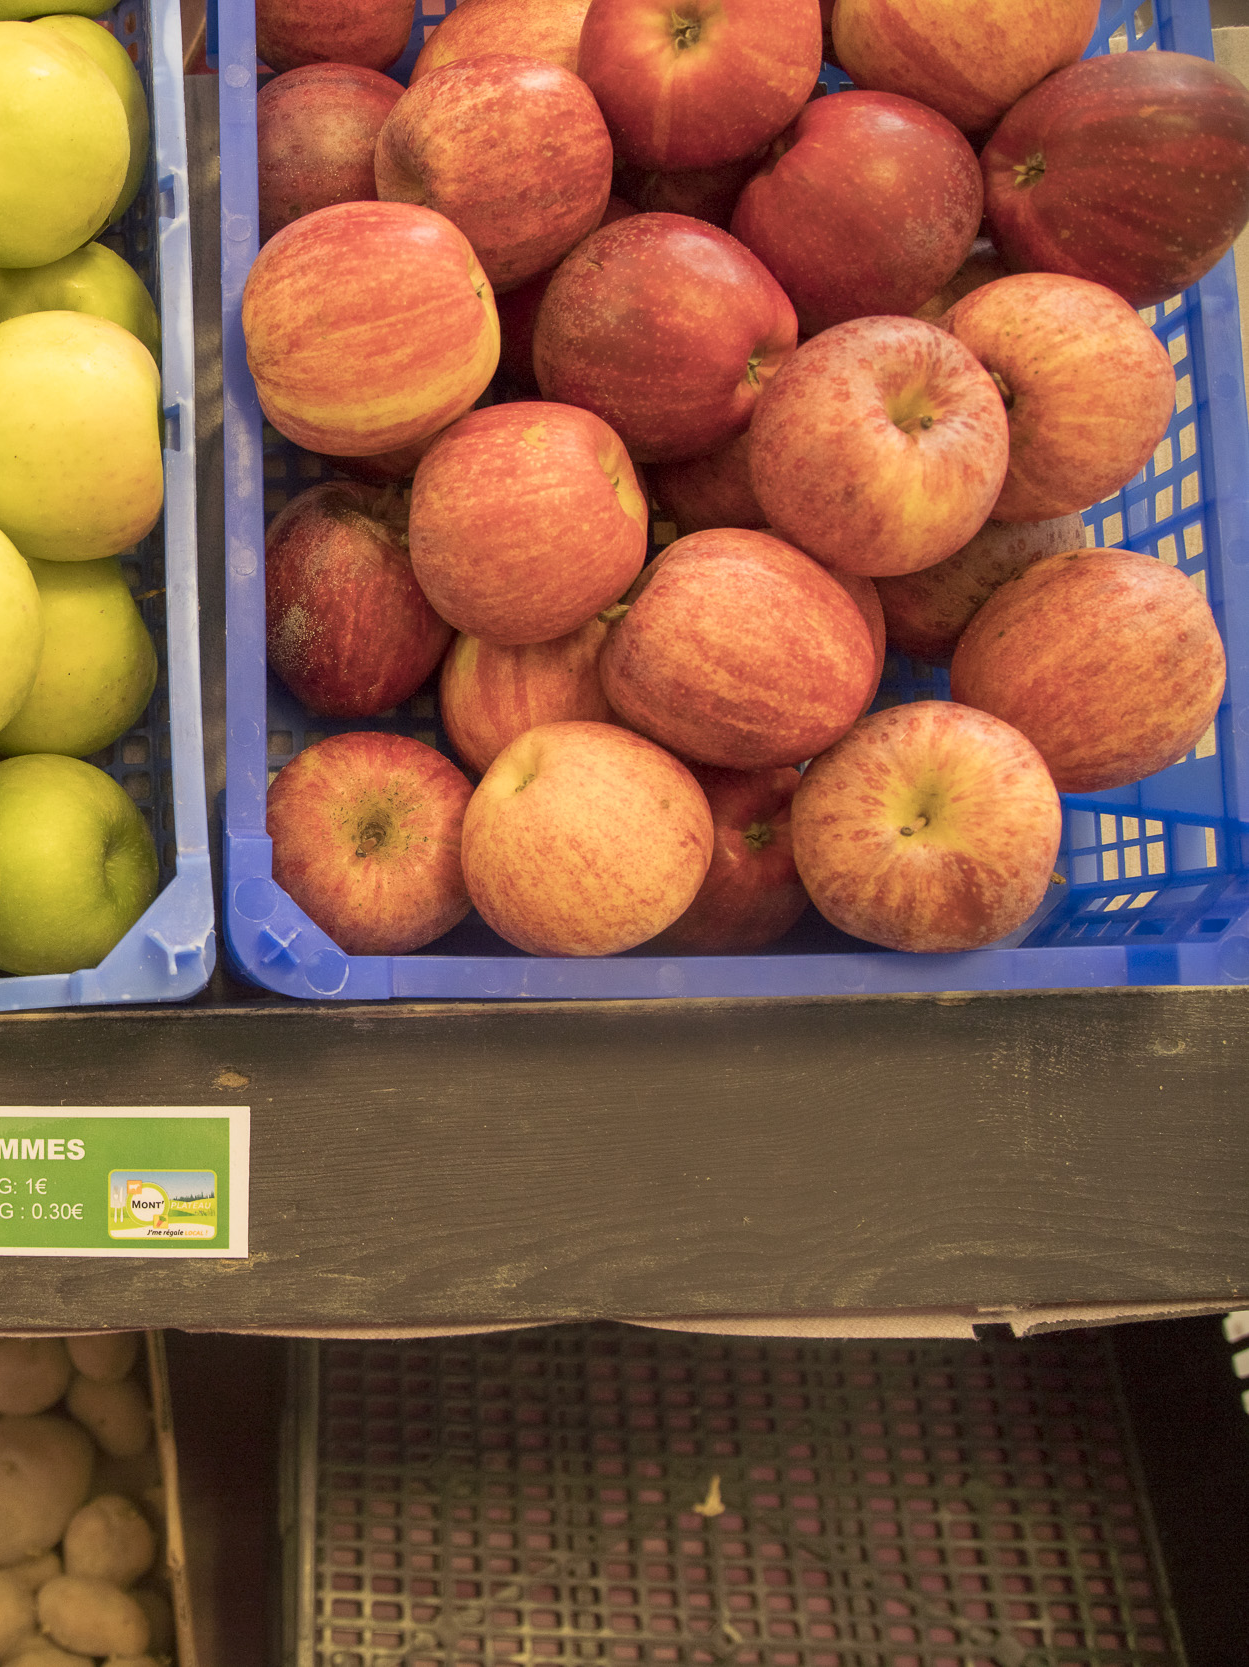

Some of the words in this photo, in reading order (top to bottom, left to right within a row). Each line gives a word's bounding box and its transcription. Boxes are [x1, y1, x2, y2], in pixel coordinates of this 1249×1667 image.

[25, 1178, 48, 1194] 1€
[31, 1203, 84, 1220] 0.30€
[163, 1229, 184, 1237] régale
